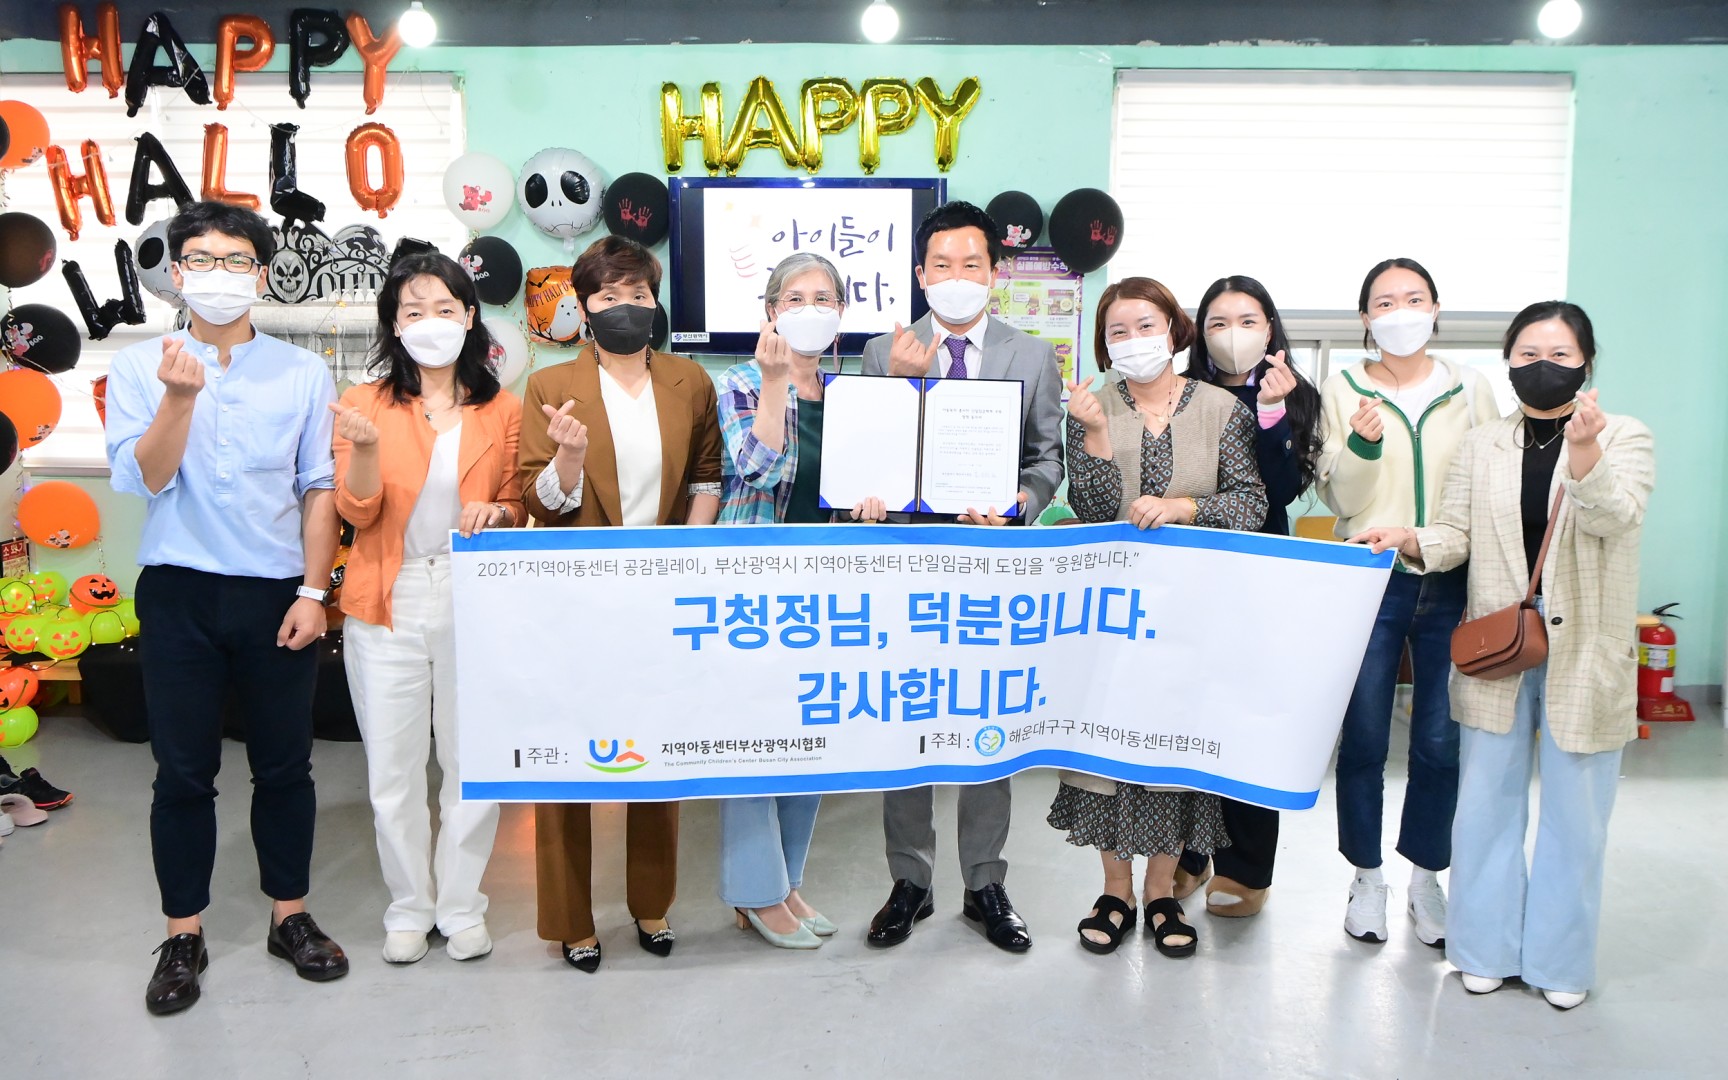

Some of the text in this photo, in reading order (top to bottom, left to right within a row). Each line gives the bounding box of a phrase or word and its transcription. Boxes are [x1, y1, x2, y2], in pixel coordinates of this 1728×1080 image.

[58, 3, 403, 118] HAPPY
[661, 75, 981, 177] HAPPY
[771, 215, 895, 259] 아이들이
[474, 271, 490, 281] BOO
[28, 334, 44, 347] BOO
[714, 556, 797, 575] 부산광역시
[804, 555, 902, 574] 지역아동센터
[908, 555, 990, 575] 단일임금제
[994, 557, 1044, 576] 도입을
[672, 586, 1156, 651] 구청정님, 덕분입니다.
[797, 666, 1047, 726] 감사합니다.
[661, 736, 826, 755] 지역아동센터부산광역시협회
[1008, 719, 1076, 743] 해운대구구
[1080, 721, 1221, 759] 지역아동센터협의회
[676, 758, 707, 767] Community
